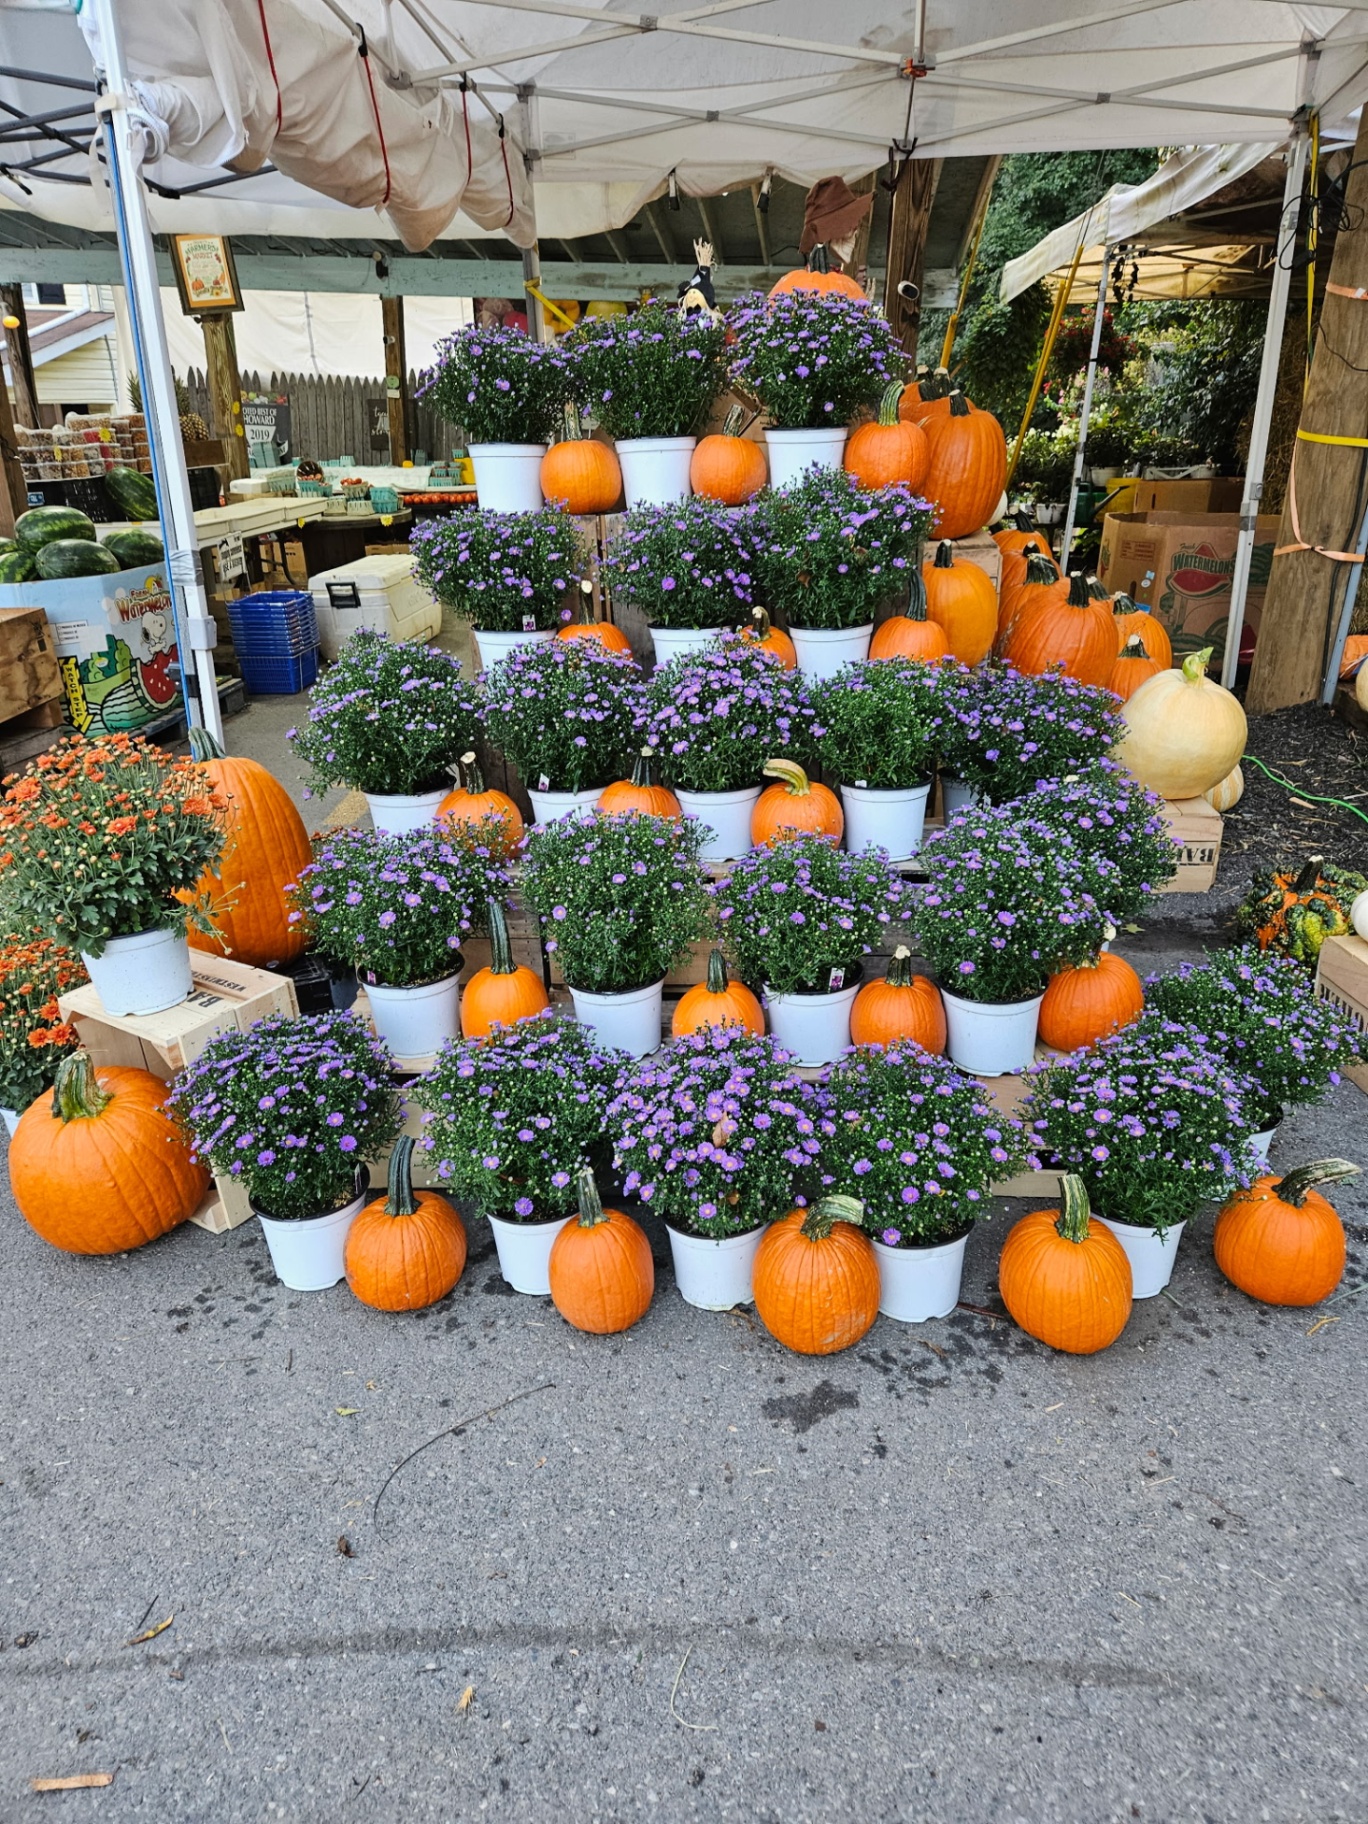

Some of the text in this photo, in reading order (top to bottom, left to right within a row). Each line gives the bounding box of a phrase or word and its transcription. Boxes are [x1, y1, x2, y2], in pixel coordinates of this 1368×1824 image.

[242, 407, 277, 416] OTED BEST OF
[244, 415, 275, 425] HOWARD
[250, 429, 270, 440] 2019
[1173, 552, 1236, 575] WATERMELONS
[65, 666, 79, 694] WATCH
[73, 696, 83, 719] STEP
